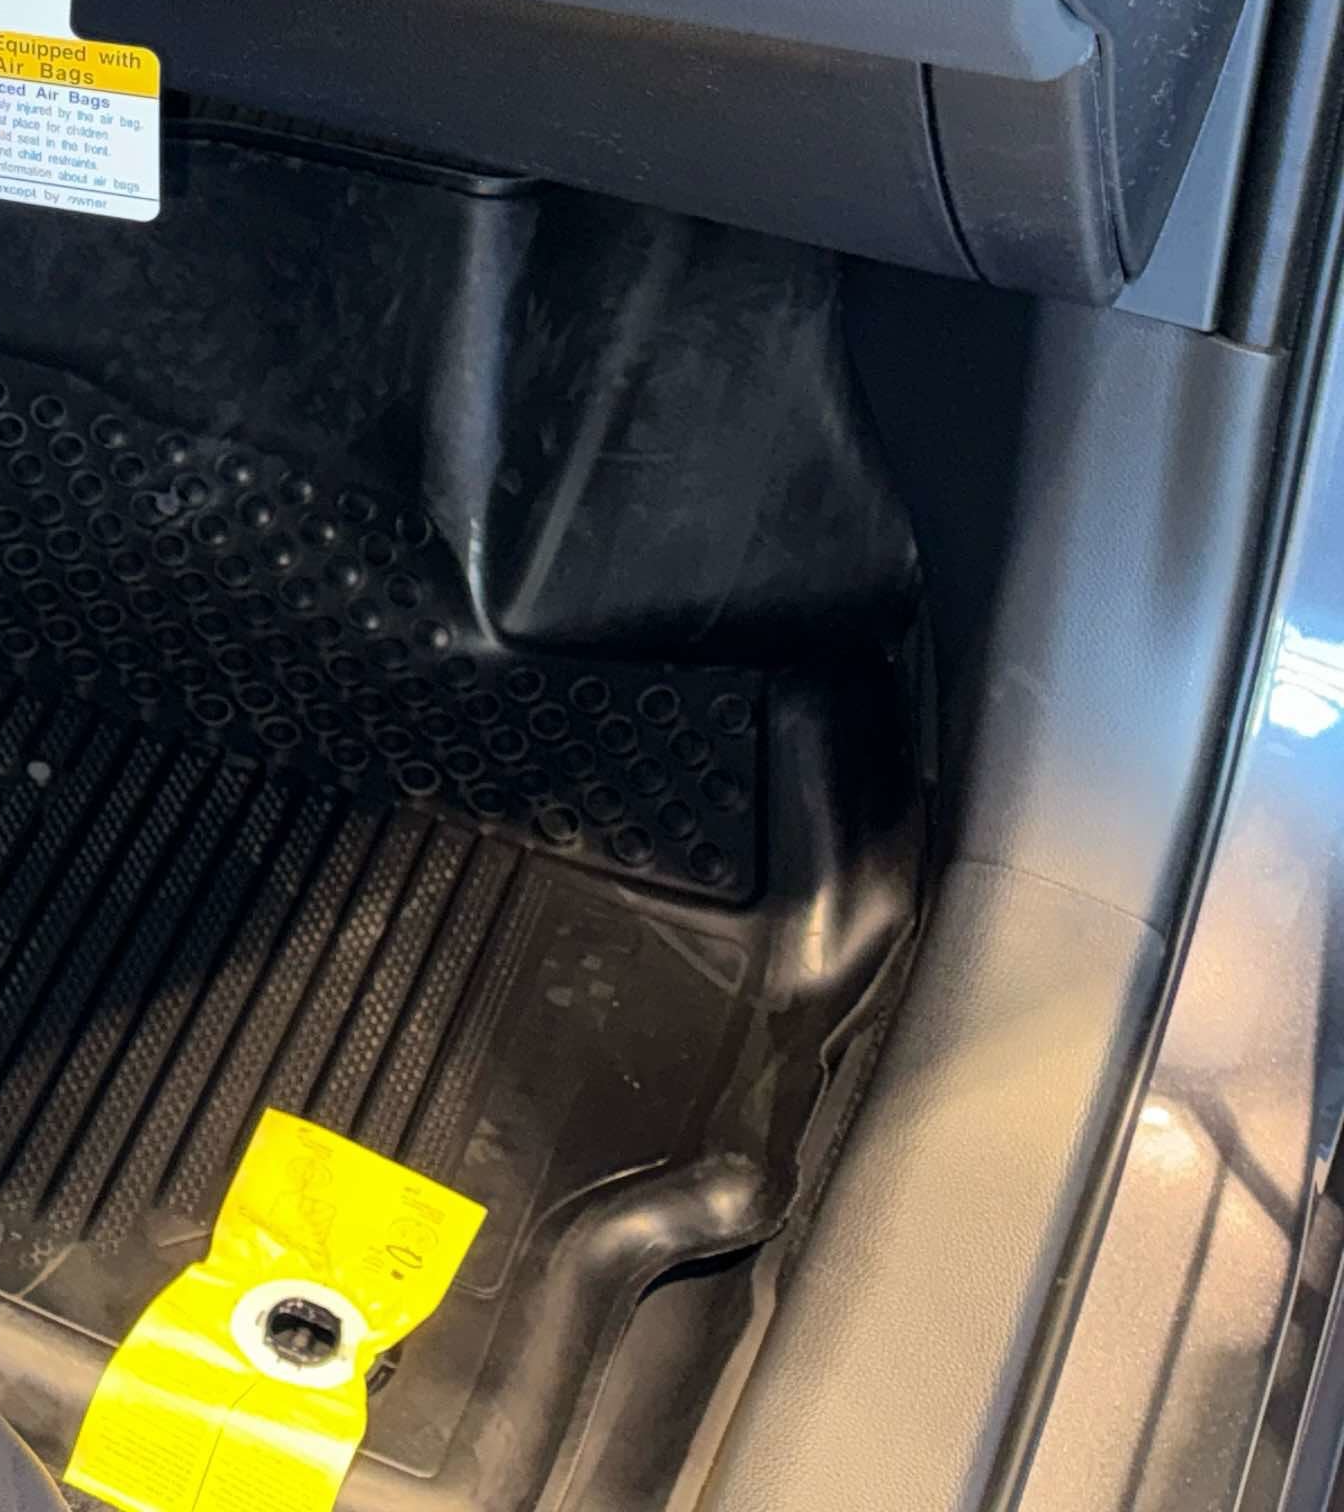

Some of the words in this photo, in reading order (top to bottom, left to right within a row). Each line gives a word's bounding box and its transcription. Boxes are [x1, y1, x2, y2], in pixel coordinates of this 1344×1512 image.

[100, 51, 141, 69] with
[40, 62, 94, 85] Bags
[36, 87, 59, 101] Air
[69, 91, 110, 109] Bags
[16, 102, 52, 117] injured
[58, 108, 72, 121] by
[77, 110, 94, 122] the
[100, 113, 114, 125] air
[12, 117, 40, 131] place
[47, 121, 60, 133] for
[17, 134, 40, 146] seat
[46, 137, 55, 148] in
[62, 139, 78, 152] the
[18, 148, 42, 161] child
[58, 170, 88, 184] about
[94, 175, 107, 186] air
[44, 189, 60, 204] by
